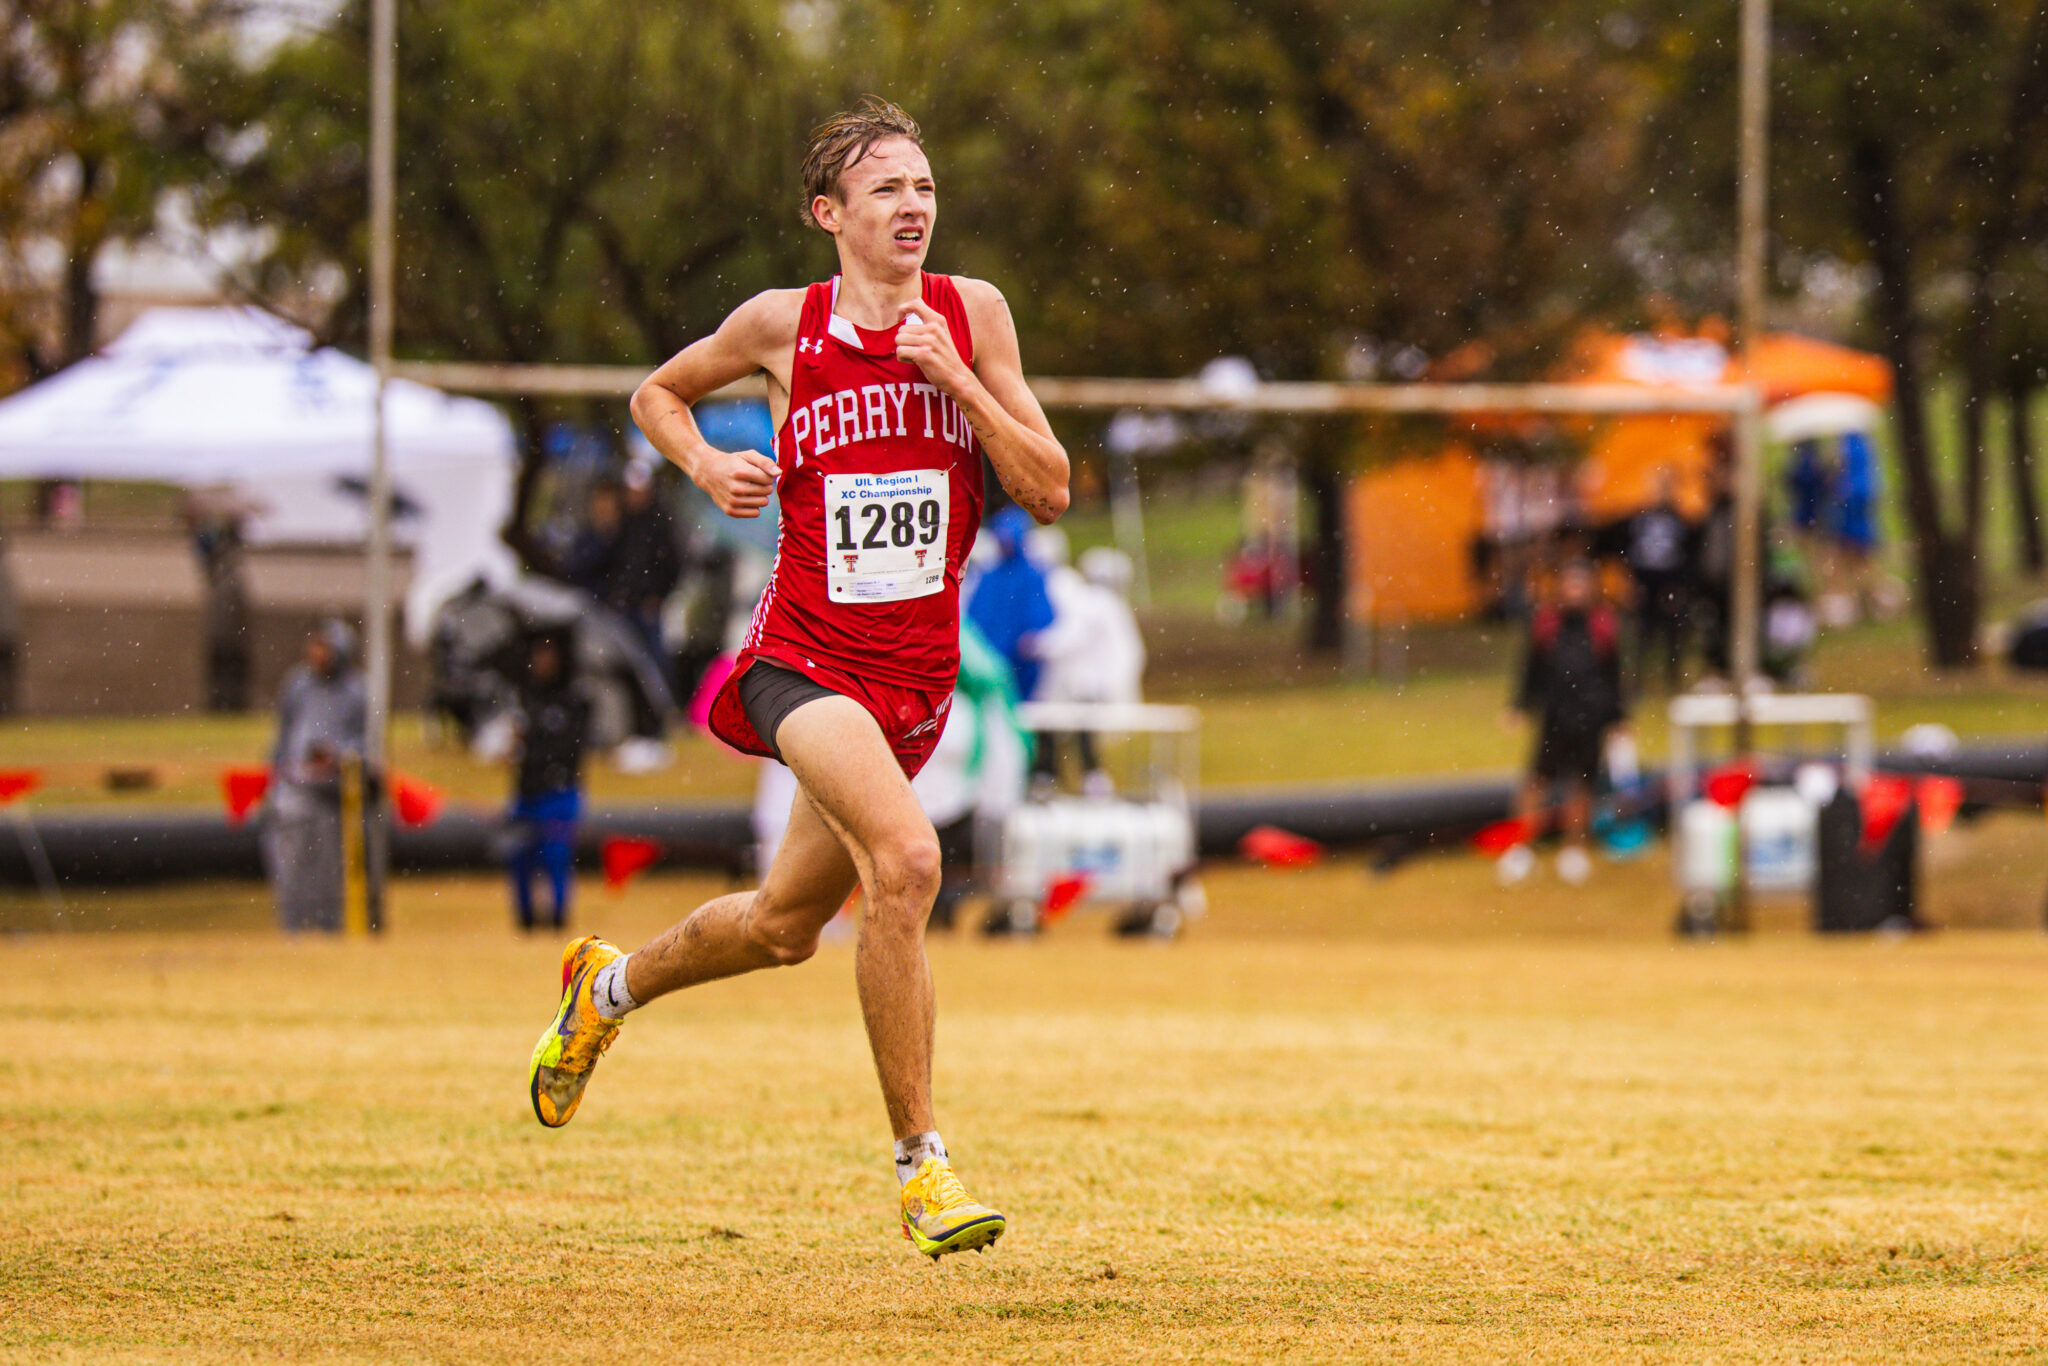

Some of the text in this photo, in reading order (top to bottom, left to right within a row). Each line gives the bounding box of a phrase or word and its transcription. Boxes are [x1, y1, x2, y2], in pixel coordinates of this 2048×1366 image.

[792, 382, 973, 469] PERRYTON
[855, 478, 873, 487] UIL
[875, 475, 912, 487] Region
[841, 485, 932, 499] XC Championship
[835, 499, 940, 551] 1289
[925, 574, 940, 585] 1289
